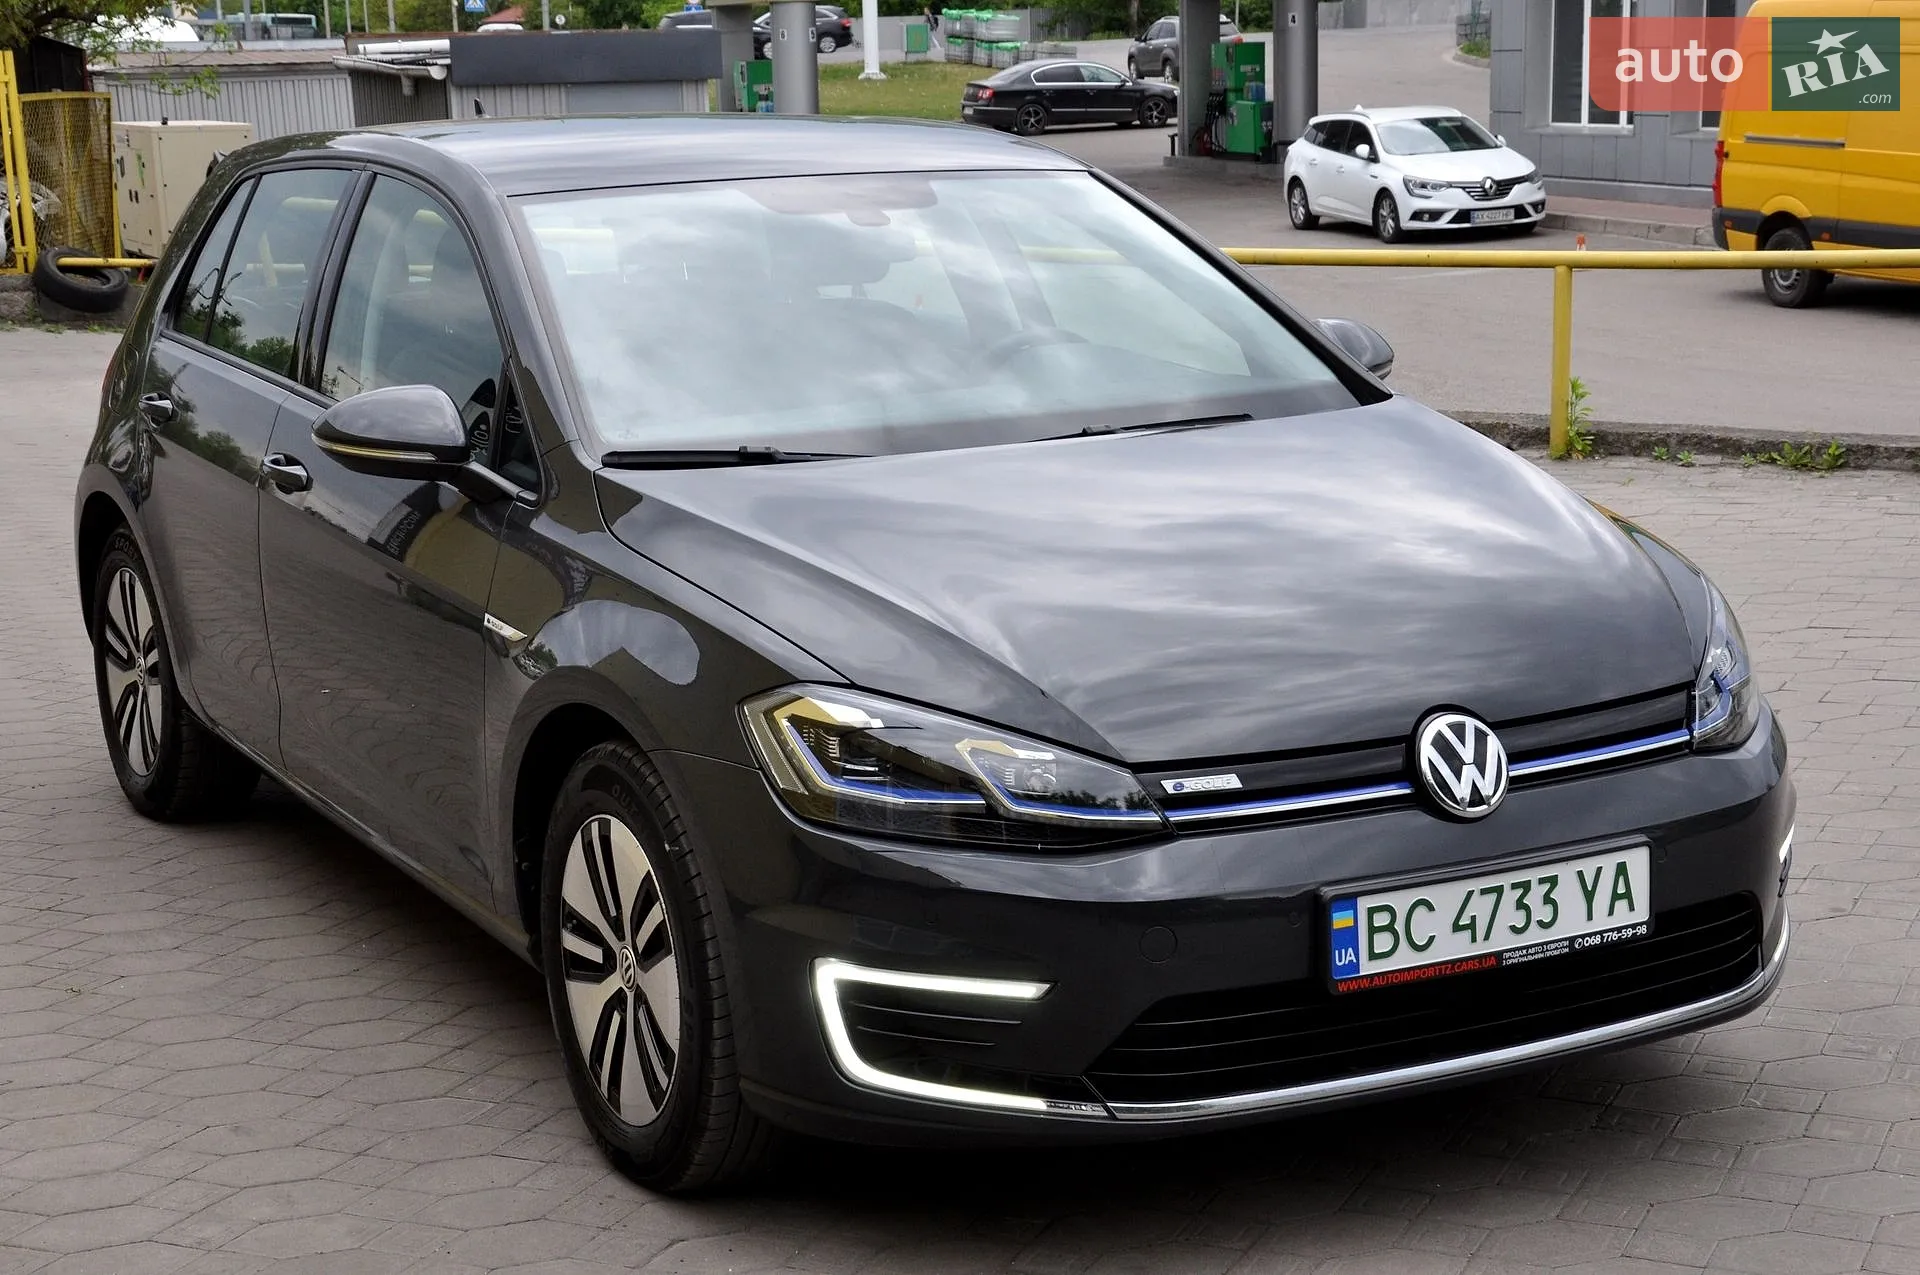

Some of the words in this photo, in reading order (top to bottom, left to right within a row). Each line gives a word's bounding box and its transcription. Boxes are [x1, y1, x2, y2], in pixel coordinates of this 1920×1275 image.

[1367, 898, 1436, 961] BC
[1452, 874, 1559, 943] 4733
[1576, 861, 1635, 921] YA
[1583, 935, 1601, 947] 068
[1602, 925, 1648, 941] 776-59-98
[1335, 947, 1356, 966] UA
[1503, 949, 1527, 959] ПРОДАЖ
[1528, 945, 1543, 954] АВТО
[1338, 957, 1497, 992] WWW.AUTOIMPORTTZ.CARS.UA
